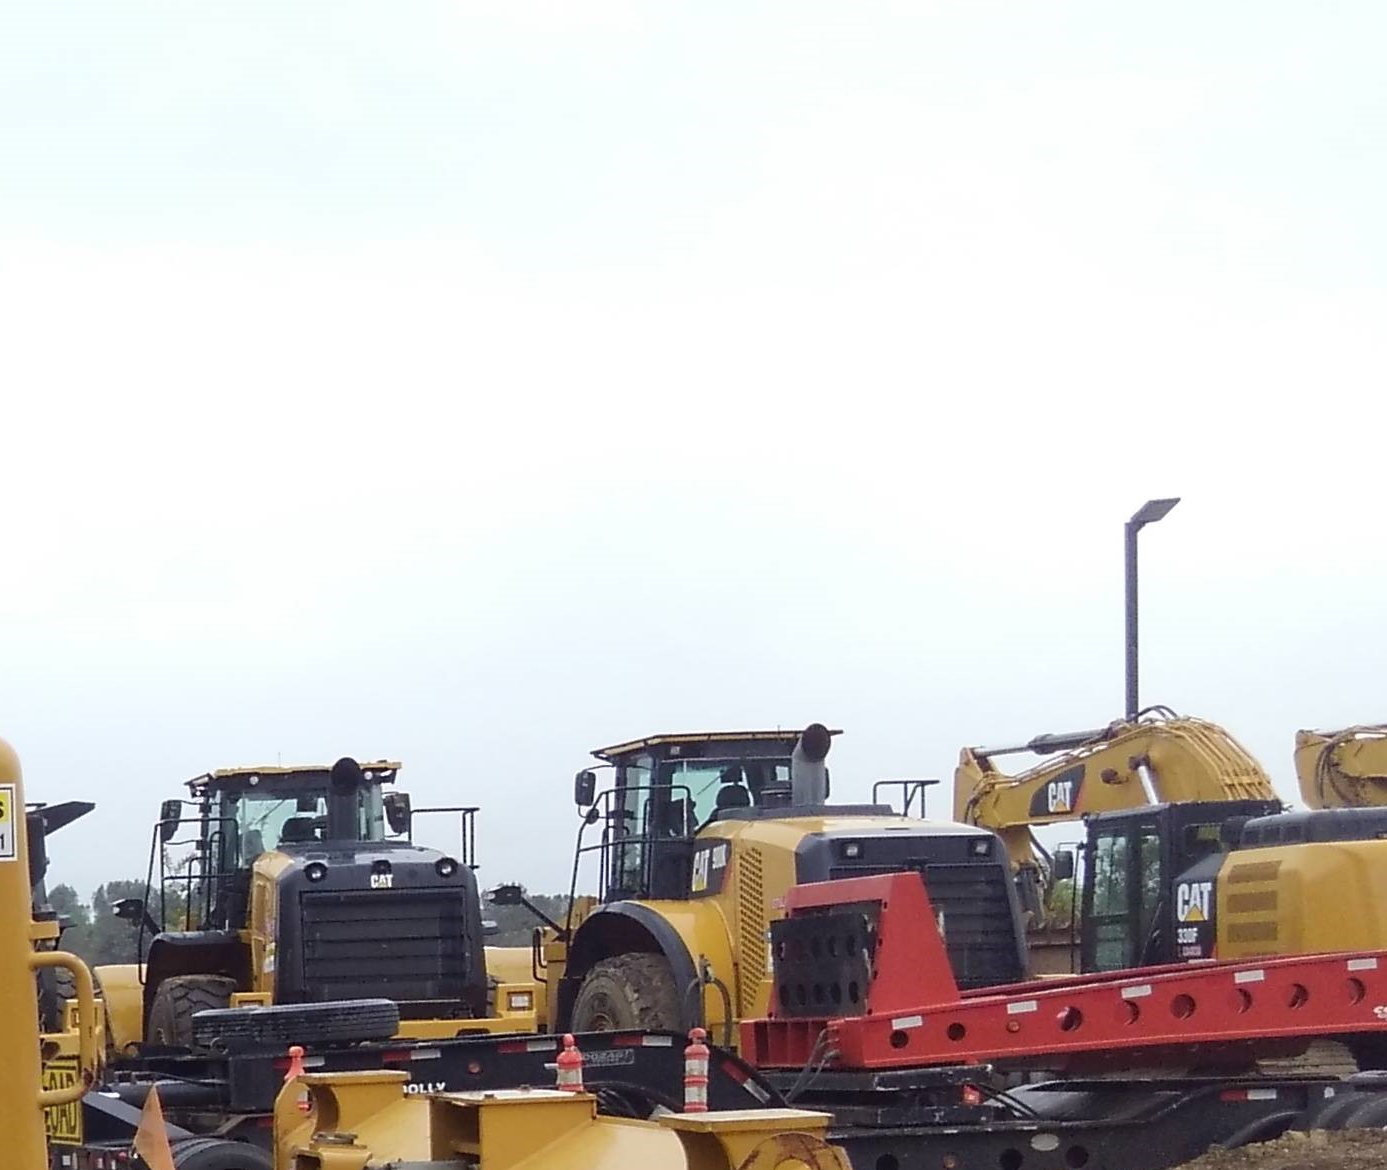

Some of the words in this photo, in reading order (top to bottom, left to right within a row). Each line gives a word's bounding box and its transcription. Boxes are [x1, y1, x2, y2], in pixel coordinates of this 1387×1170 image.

[1048, 781, 1072, 813] CAT
[371, 874, 394, 888] CAT
[1177, 882, 1212, 922] CAT
